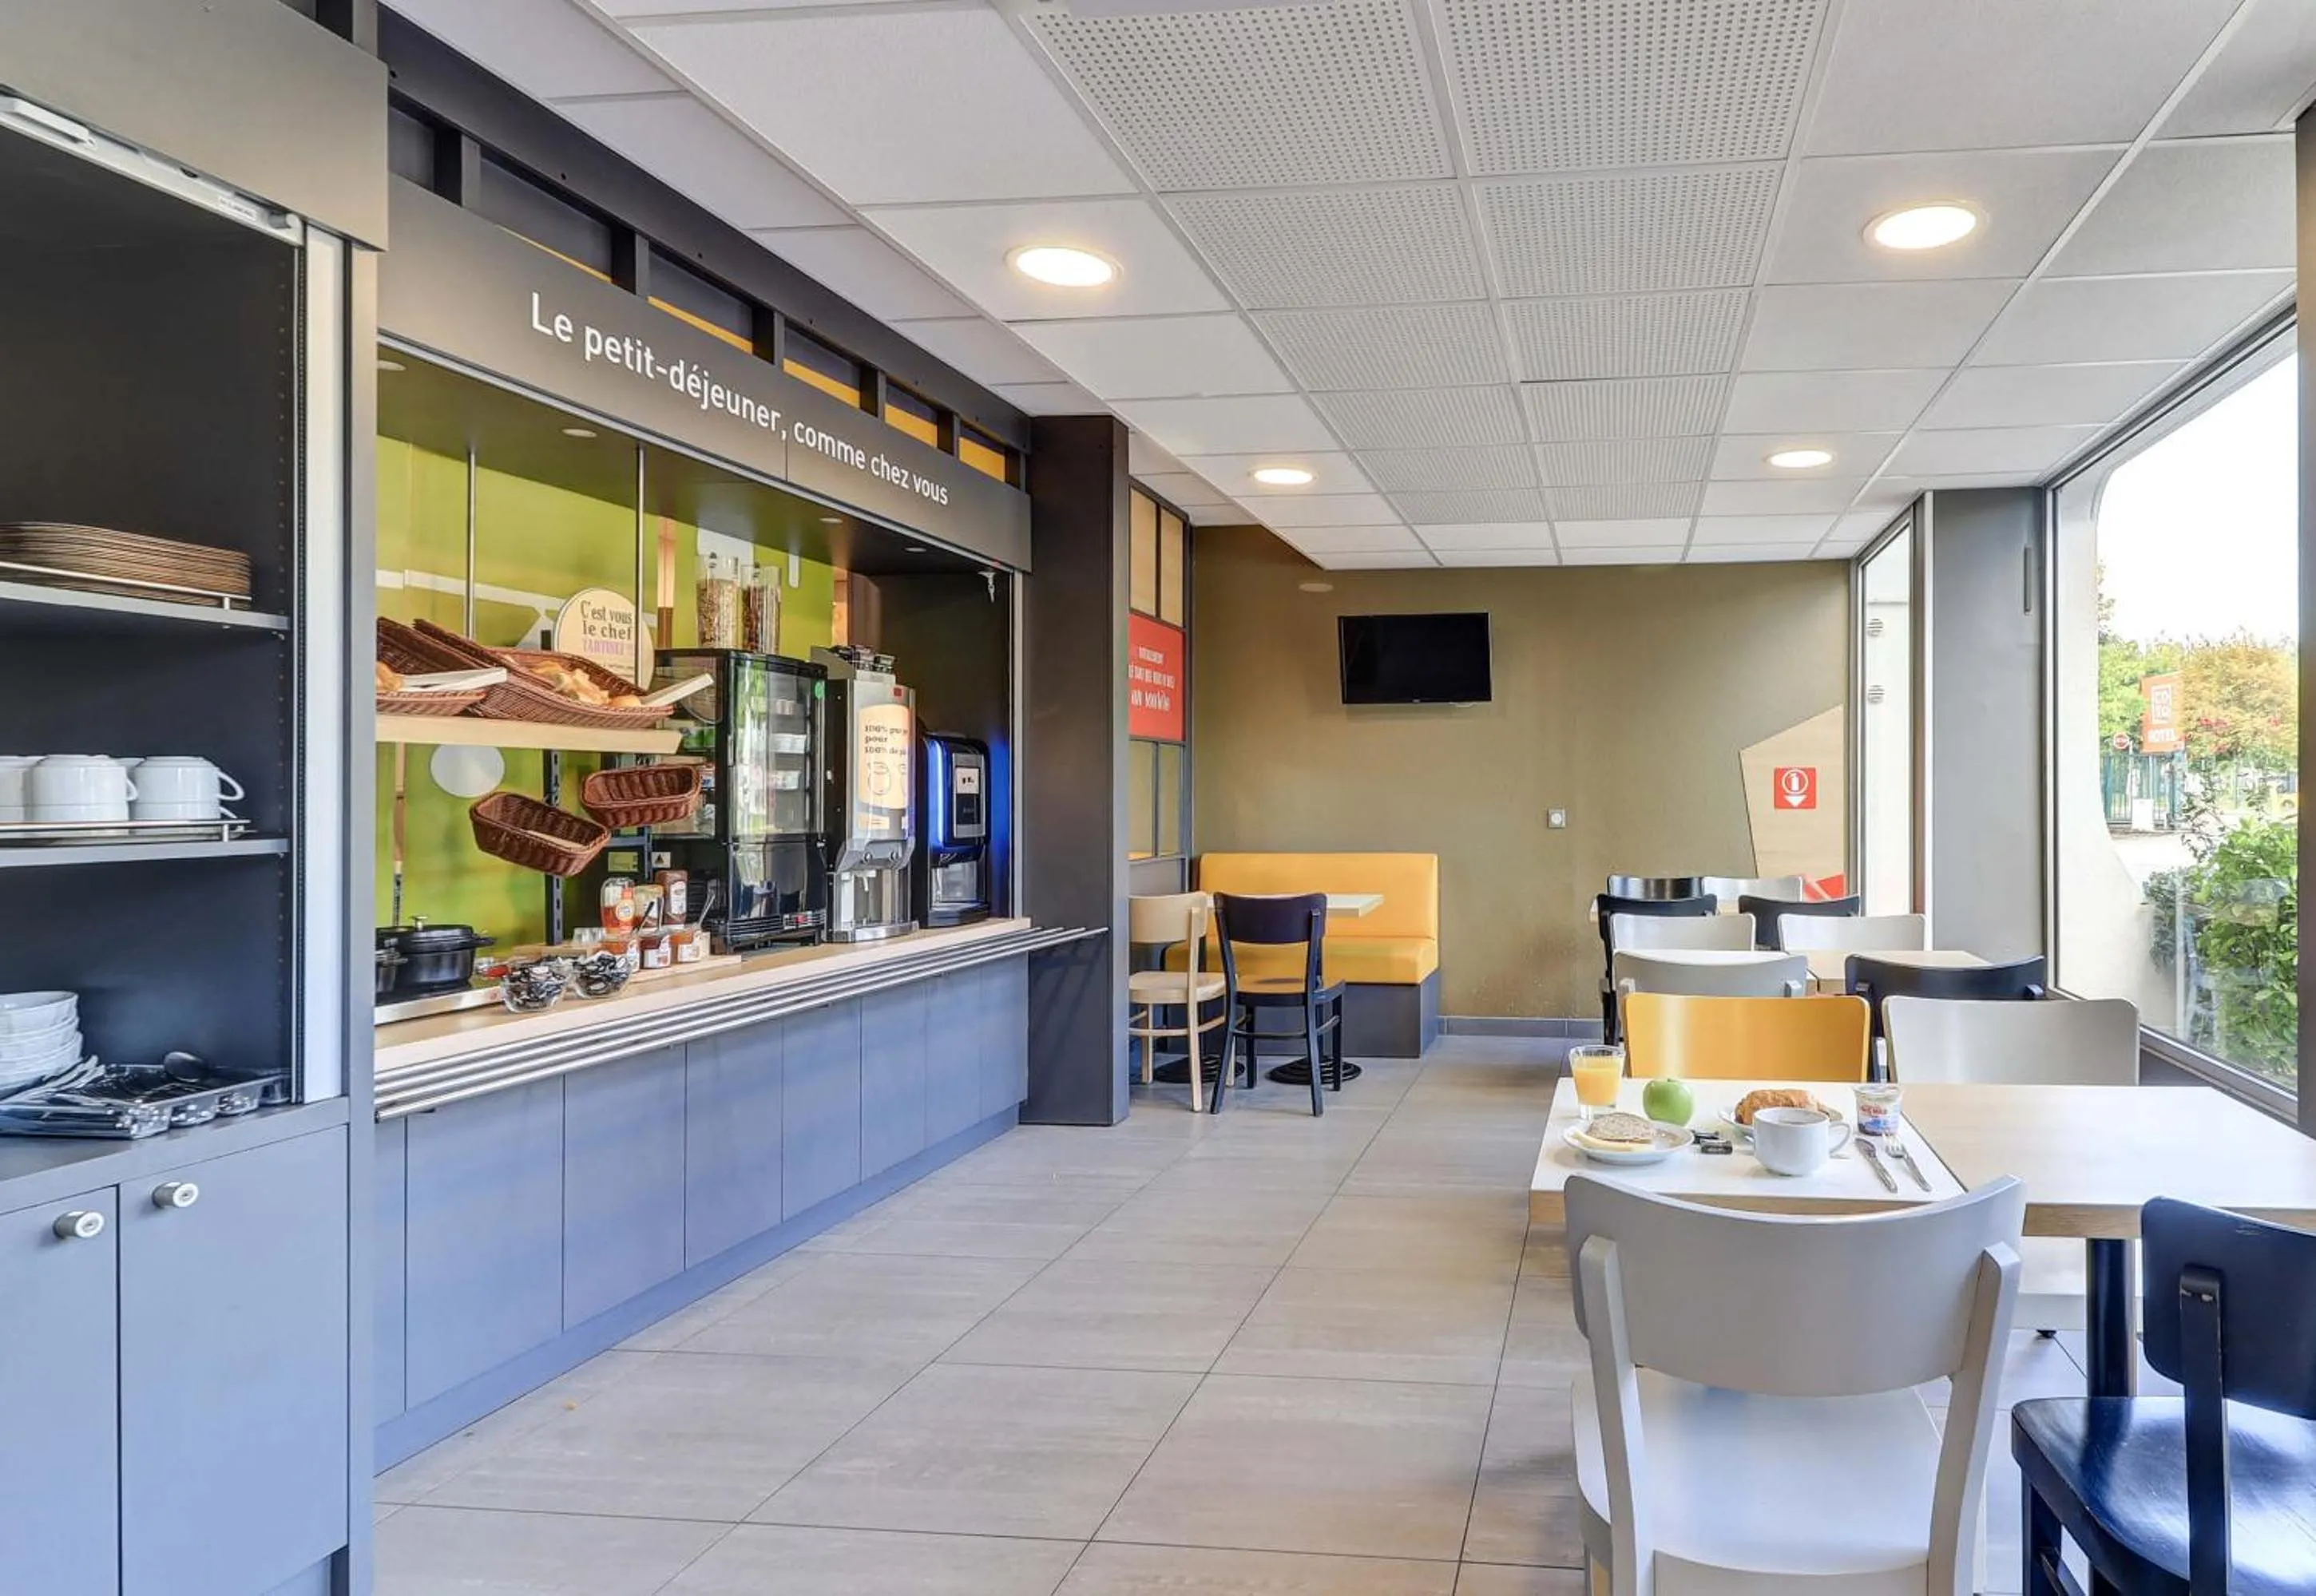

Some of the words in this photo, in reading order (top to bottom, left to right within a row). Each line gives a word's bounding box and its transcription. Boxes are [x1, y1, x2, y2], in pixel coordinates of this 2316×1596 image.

[532, 292, 573, 342] Le
[585, 326, 787, 441] petit-déjeuner,
[794, 422, 866, 469] comme
[871, 453, 910, 489] chez
[913, 474, 949, 505] vous
[581, 600, 606, 621] C'est
[609, 609, 633, 624] vous
[582, 620, 596, 636] le
[601, 623, 633, 640] chef
